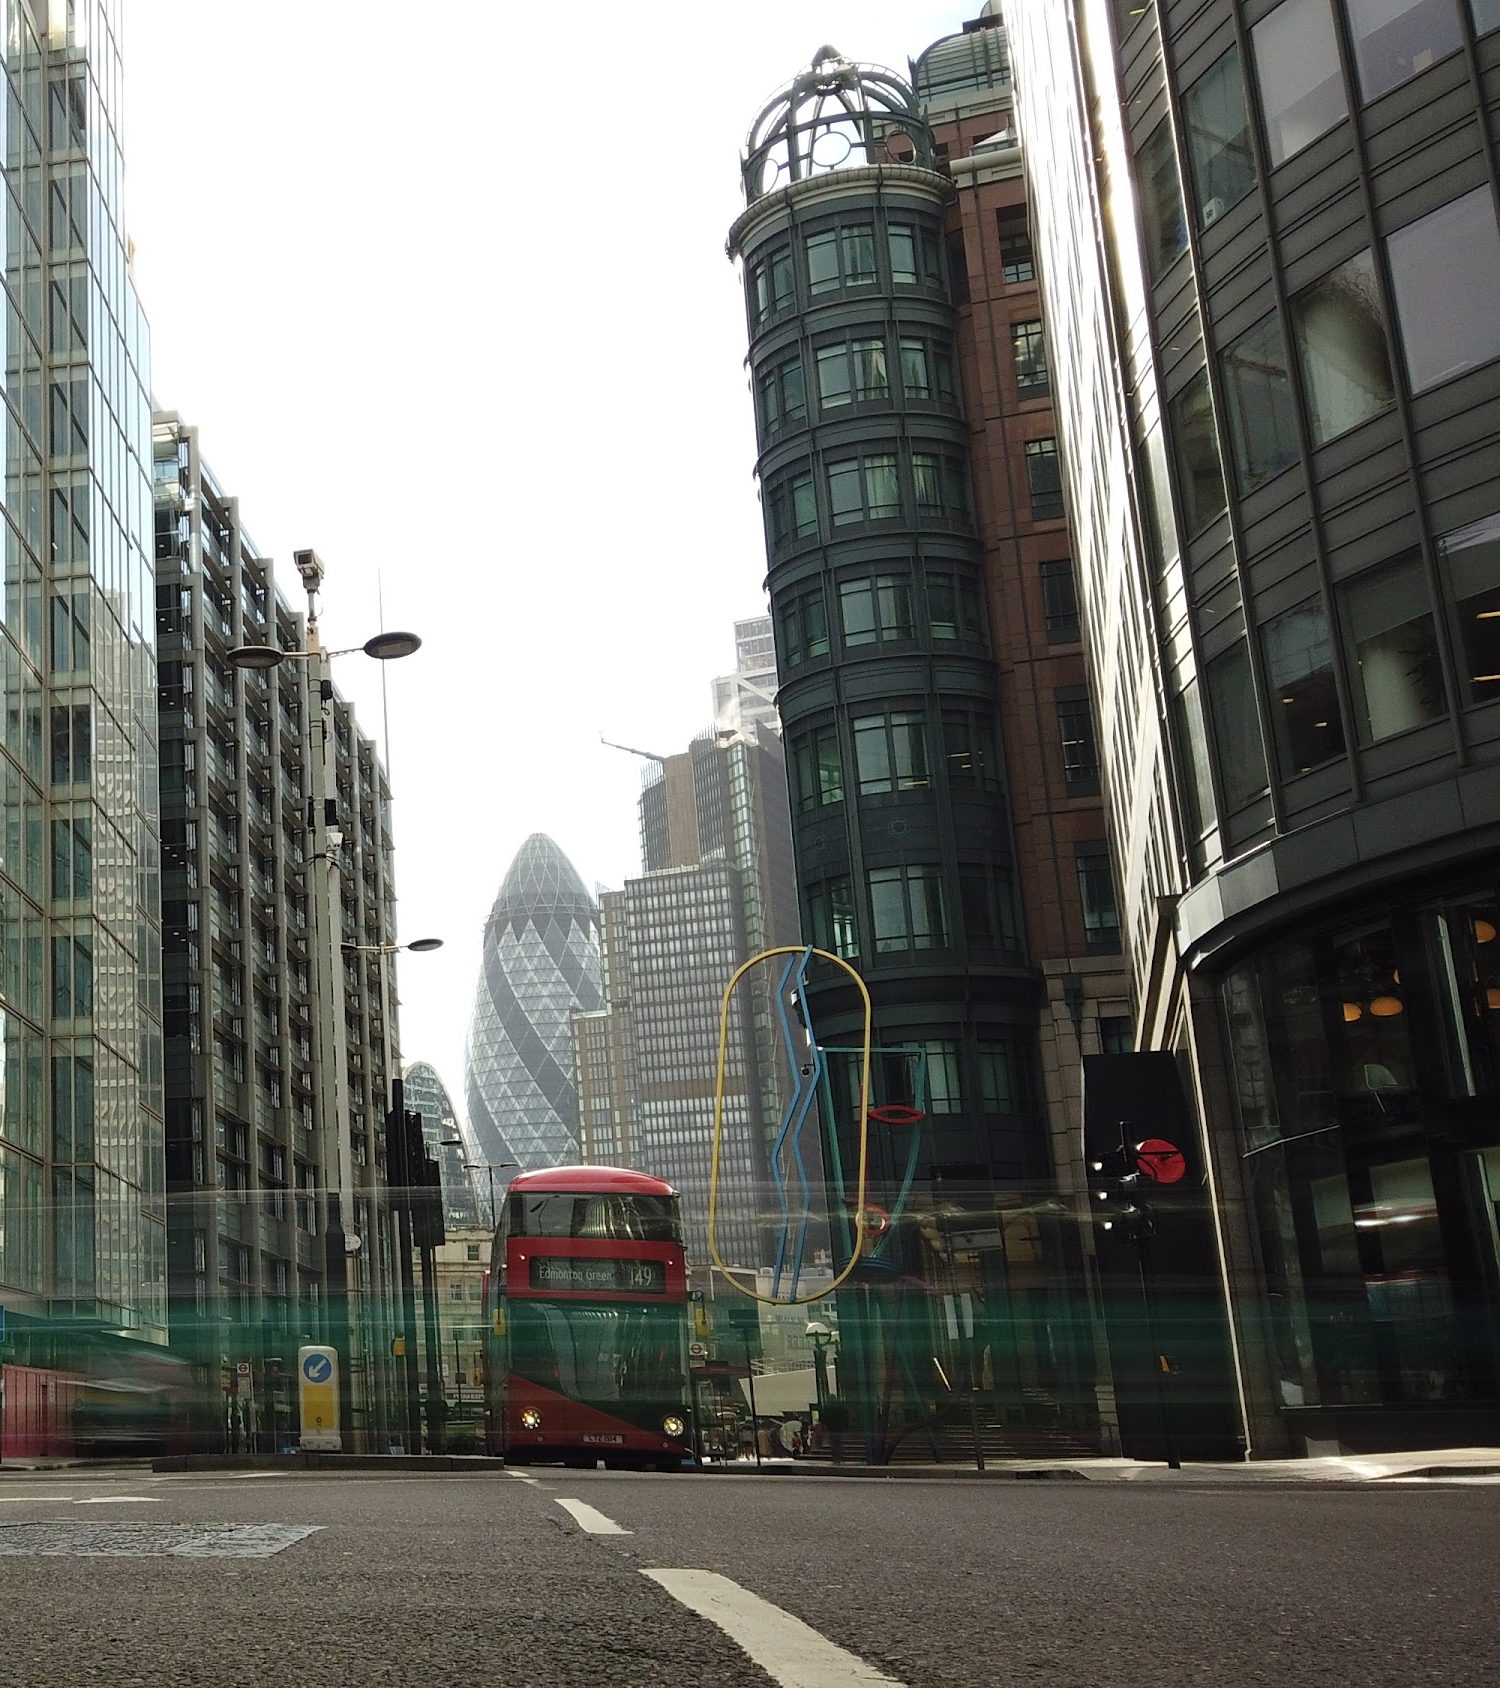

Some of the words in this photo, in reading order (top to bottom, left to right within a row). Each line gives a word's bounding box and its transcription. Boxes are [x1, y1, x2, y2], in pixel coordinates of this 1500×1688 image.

[539, 1266, 583, 1280] Edmonton
[586, 1268, 612, 1281] Green
[630, 1266, 652, 1286] 149
